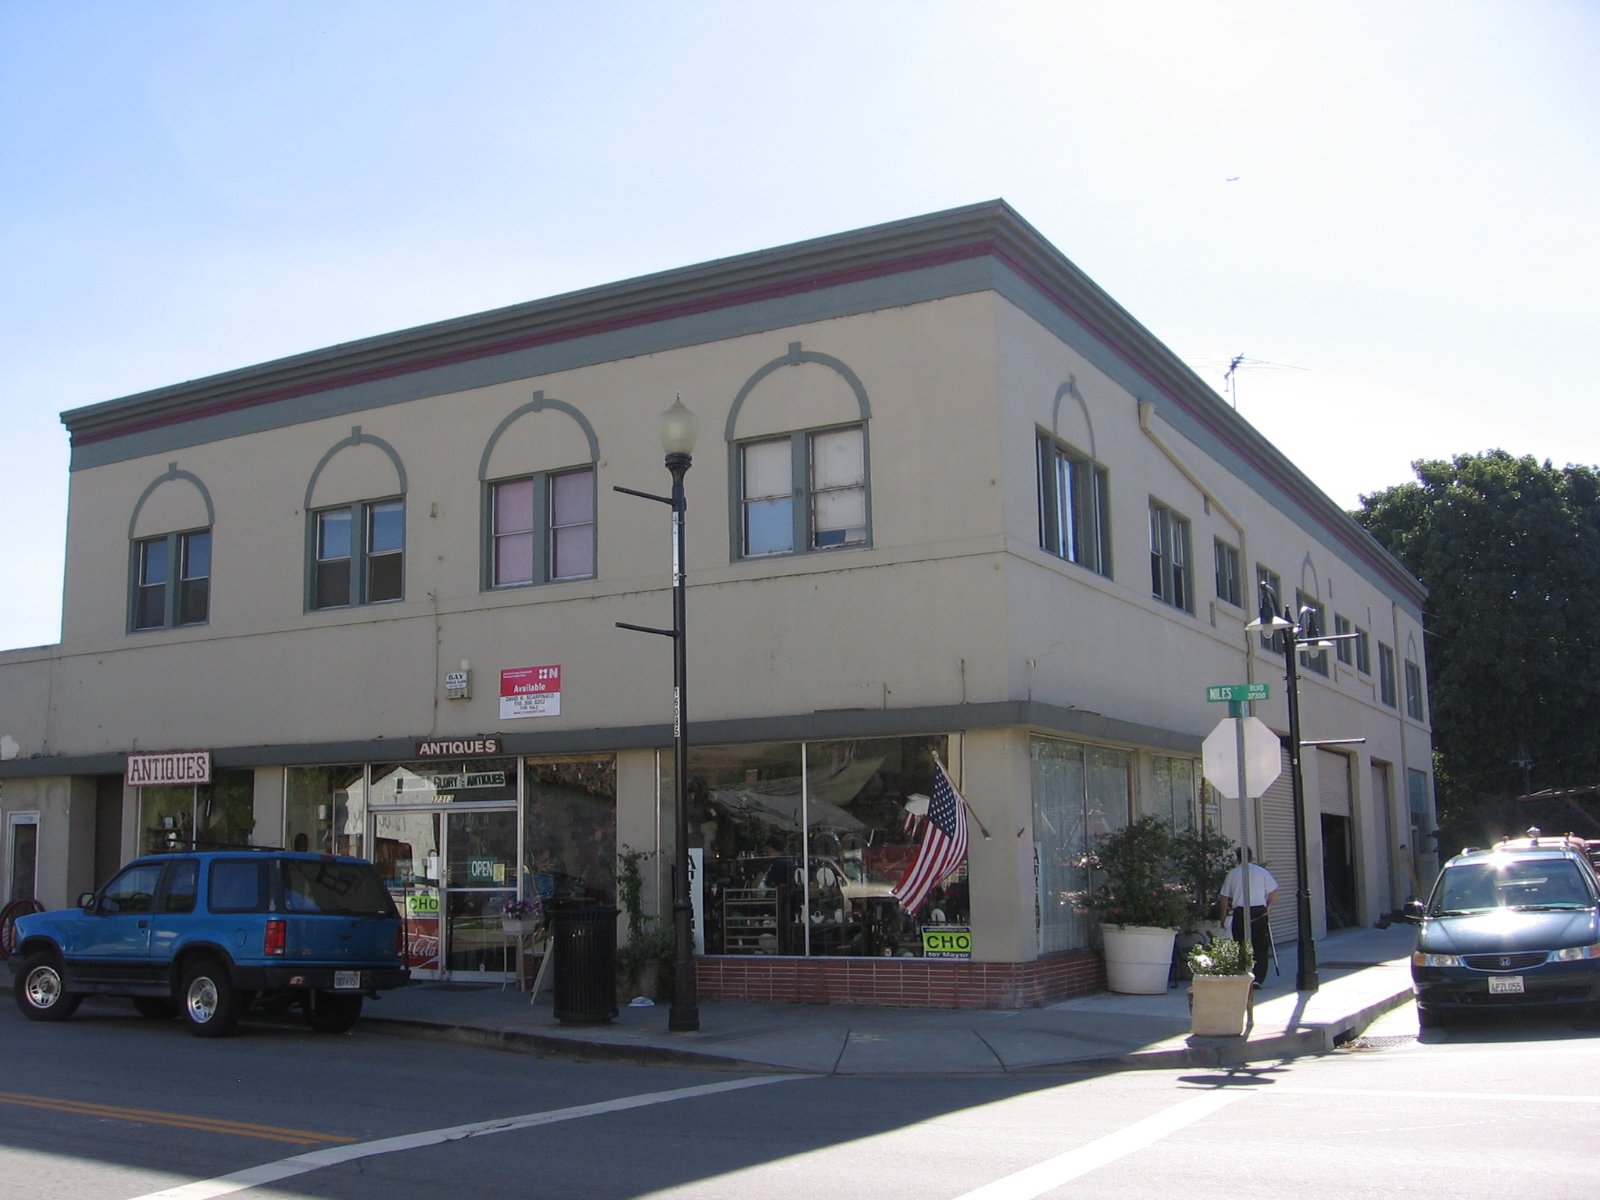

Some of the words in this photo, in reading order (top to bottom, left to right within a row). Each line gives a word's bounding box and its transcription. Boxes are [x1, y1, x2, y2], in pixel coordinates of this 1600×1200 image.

[513, 683, 546, 693] Available
[1209, 687, 1232, 700] NILES
[419, 740, 496, 755] ANTIQUES
[130, 756, 206, 781] ANTIQUES
[467, 773, 504, 786] ANTIQUES
[471, 861, 493, 876] OPEN
[409, 898, 439, 910] CHO
[927, 935, 970, 949] CHO
